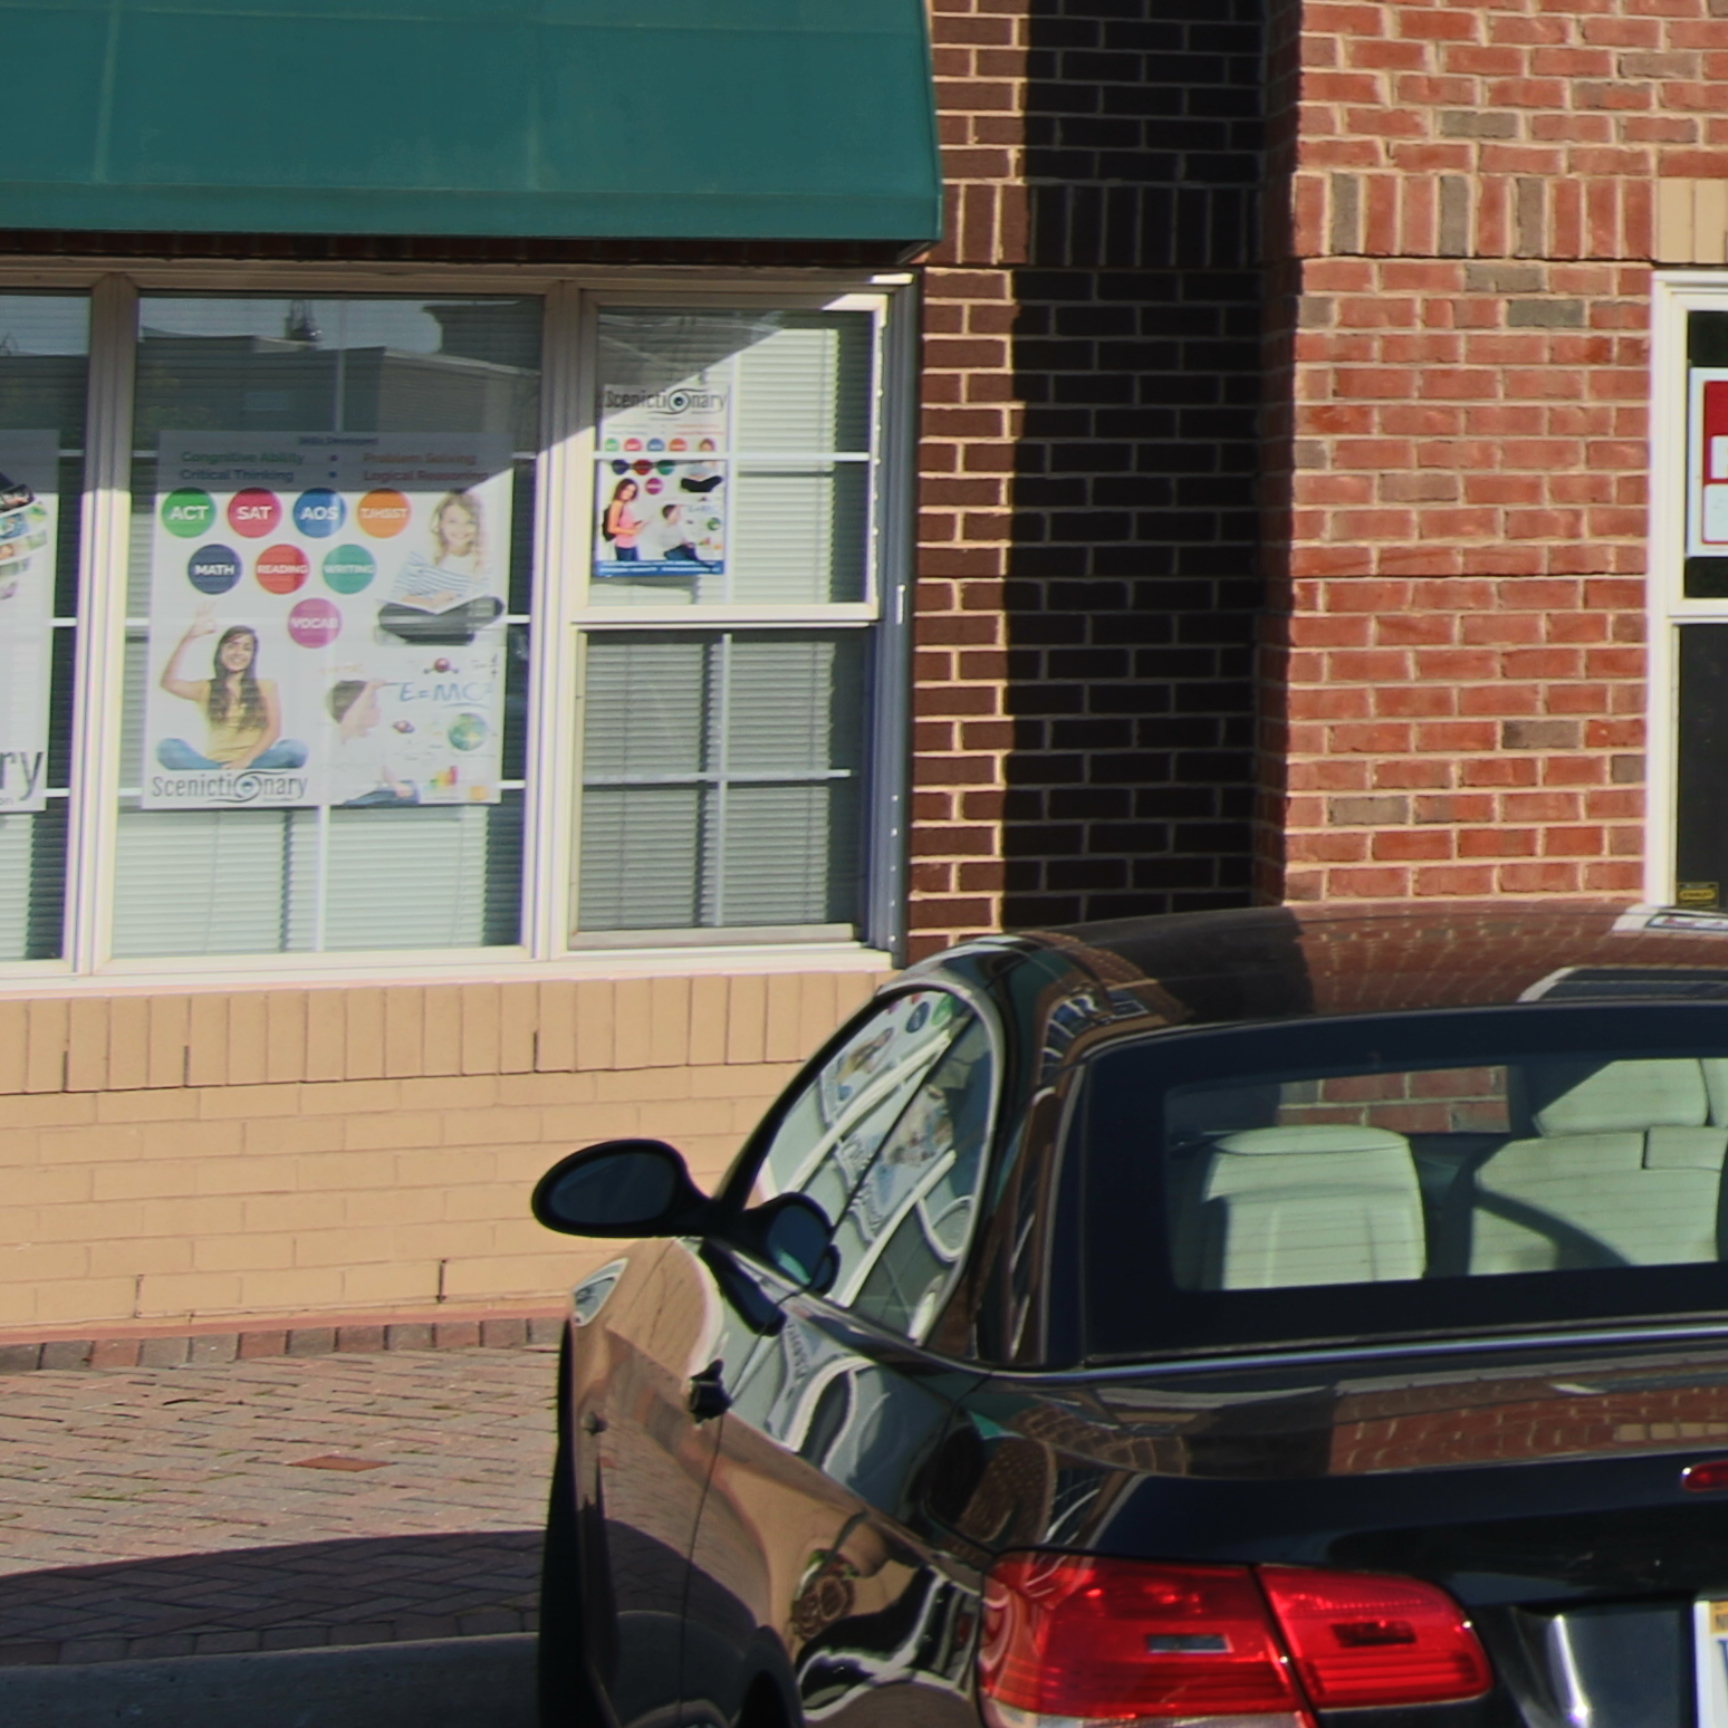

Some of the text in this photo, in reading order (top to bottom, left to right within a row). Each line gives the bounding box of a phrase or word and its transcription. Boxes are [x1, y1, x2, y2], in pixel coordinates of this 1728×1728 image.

[180, 468, 294, 483] Critical Thinking
[363, 469, 414, 483] Logical
[169, 505, 209, 520] ACT
[237, 505, 272, 520] SAT
[301, 506, 341, 520] AOS
[194, 564, 375, 575] MATH READING WRITING
[292, 618, 339, 629] VOCAB
[152, 772, 308, 801] Scenictionary
